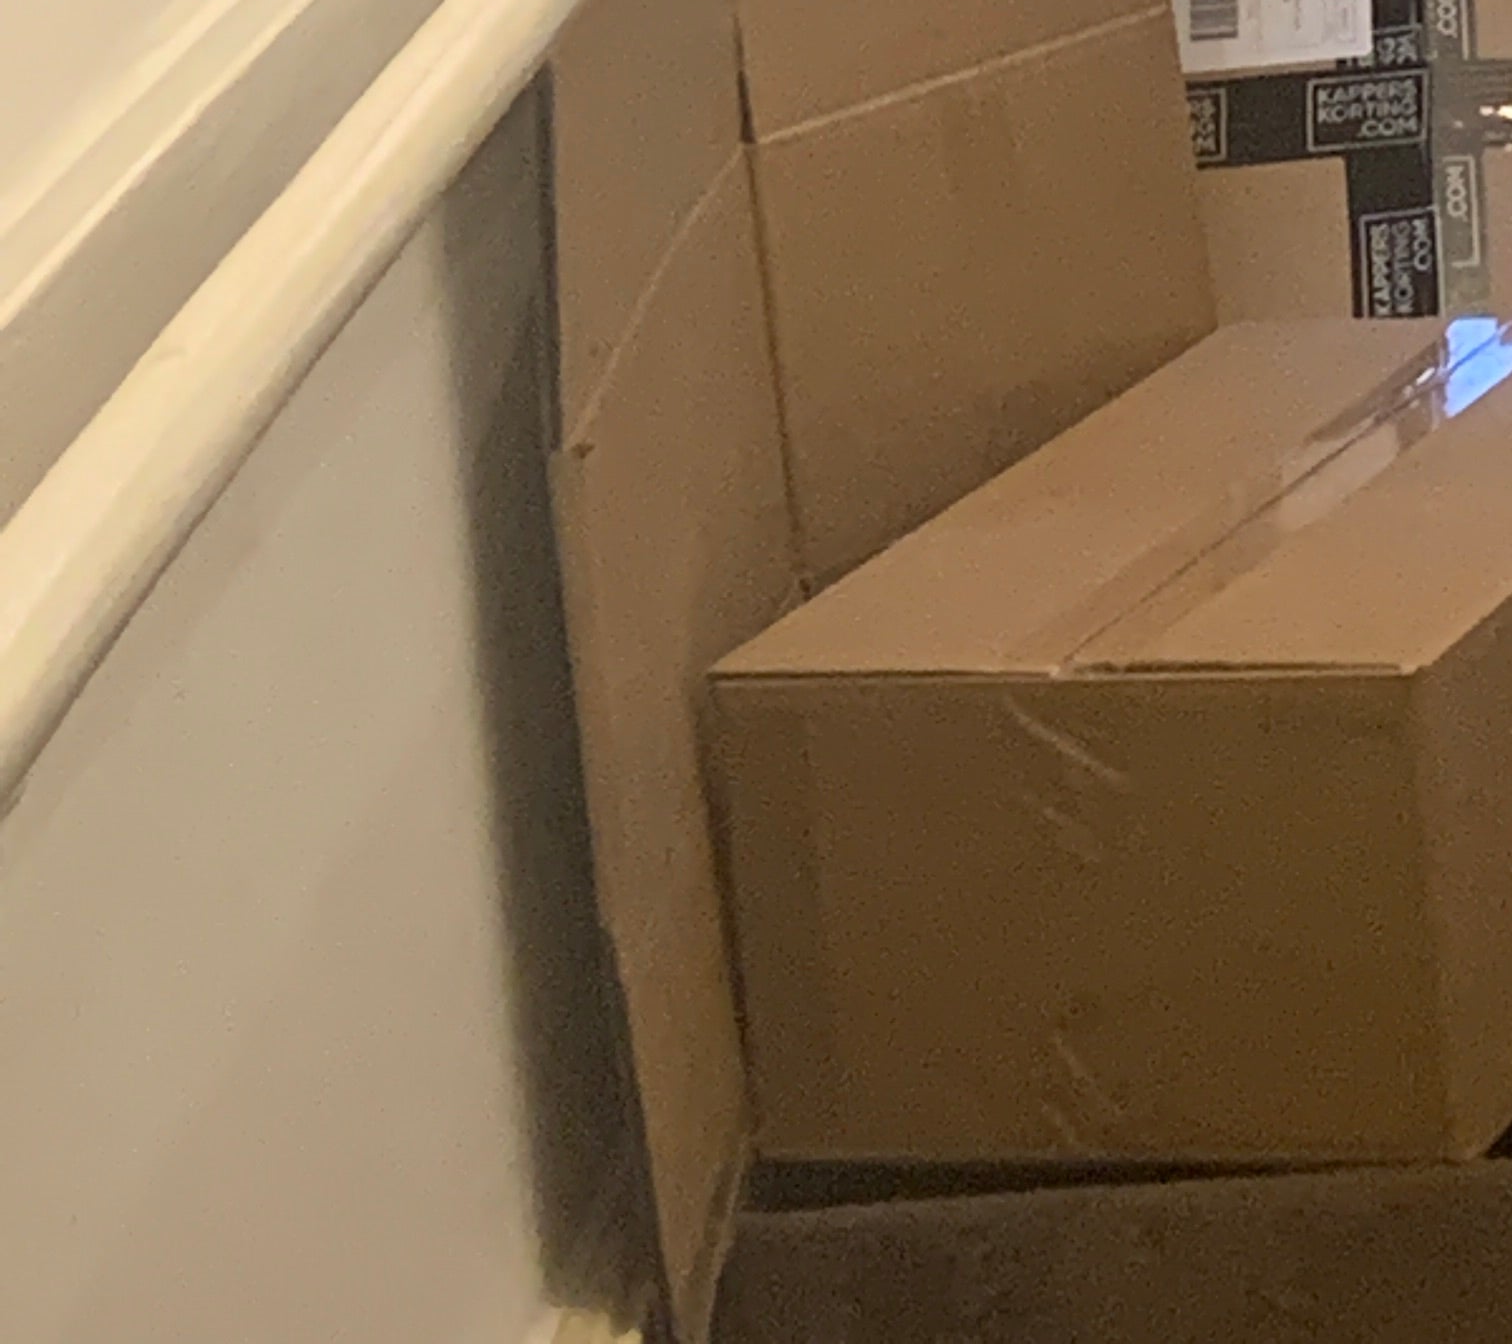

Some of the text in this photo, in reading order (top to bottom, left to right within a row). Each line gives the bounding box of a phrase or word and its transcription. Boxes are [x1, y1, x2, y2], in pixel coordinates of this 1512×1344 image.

[1316, 78, 1418, 105] KAPPERS
[1317, 96, 1418, 123] KORTING
[1356, 114, 1418, 138] .COM
[1446, 162, 1468, 223] .COM
[1370, 222, 1392, 316] KAPPERS
[1391, 219, 1415, 314] KORTING
